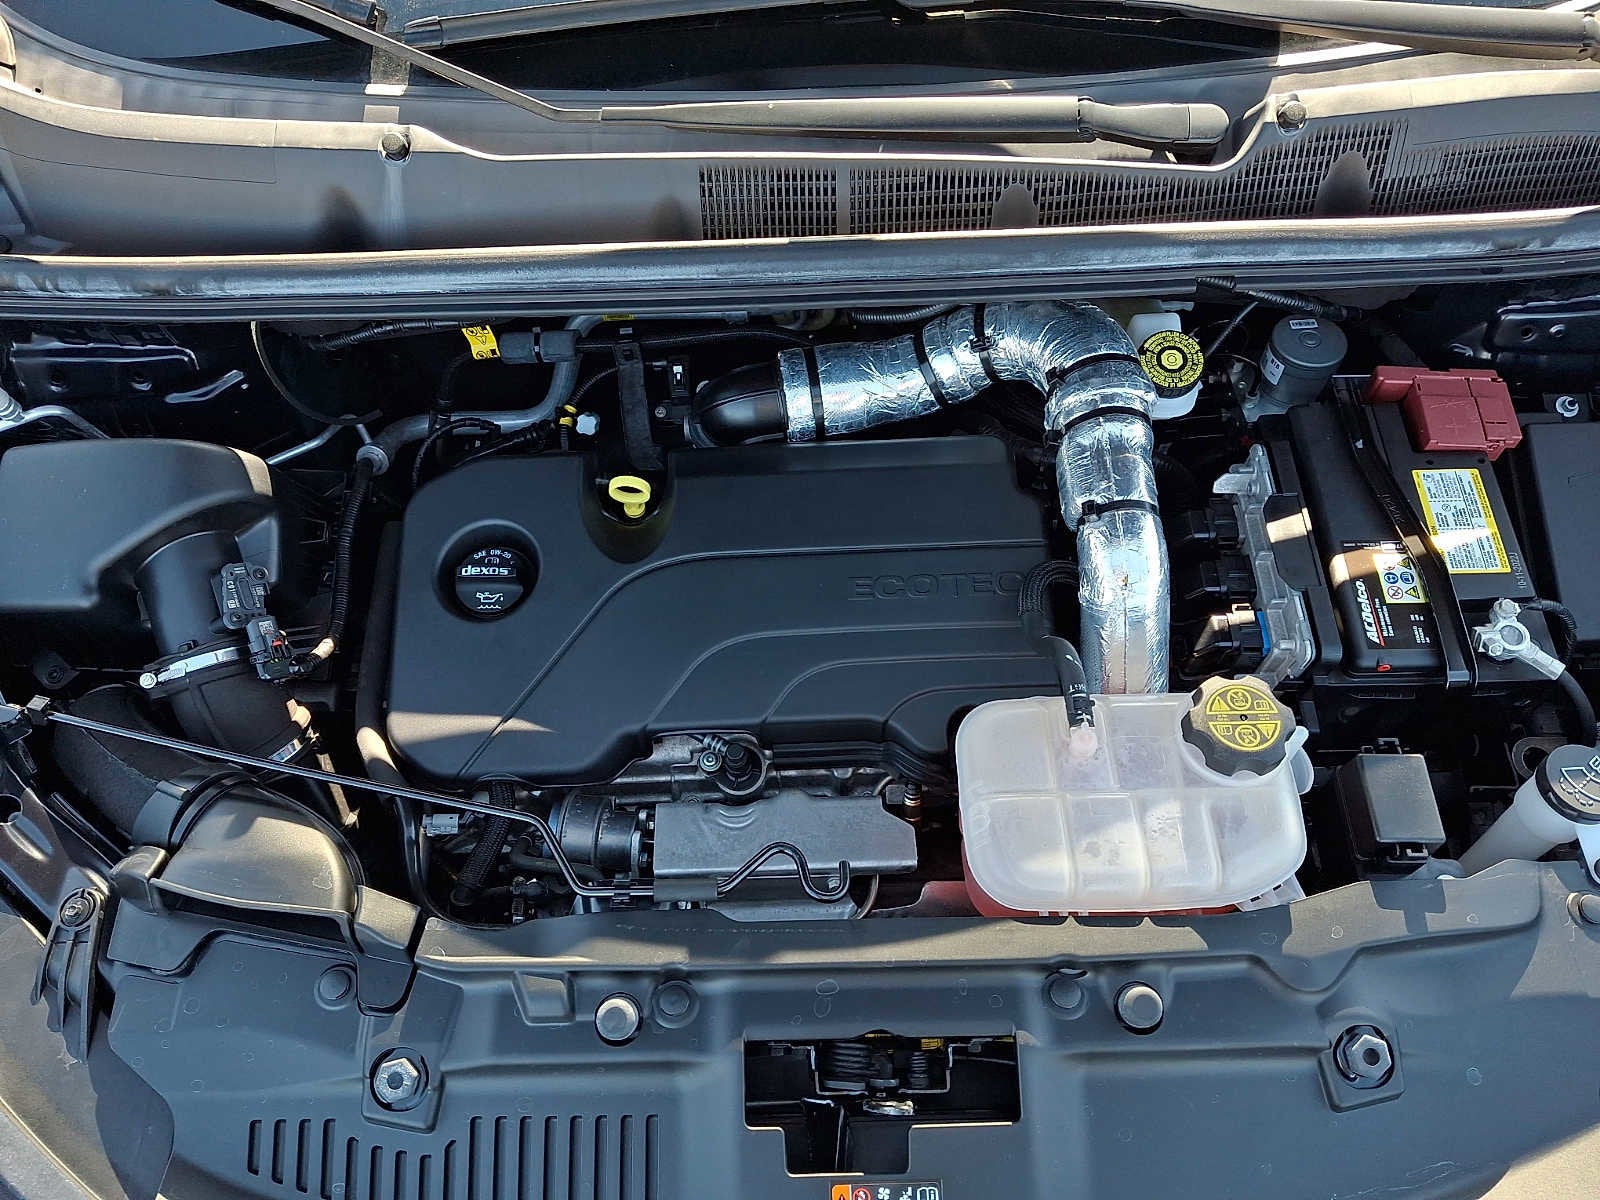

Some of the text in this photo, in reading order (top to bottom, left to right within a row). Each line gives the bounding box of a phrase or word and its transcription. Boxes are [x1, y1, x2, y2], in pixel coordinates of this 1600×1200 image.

[473, 549, 512, 560] SAE 0W-20
[461, 565, 509, 576] dexos
[848, 571, 1026, 600] ECOTEC
[1355, 580, 1380, 643] ACDelco
